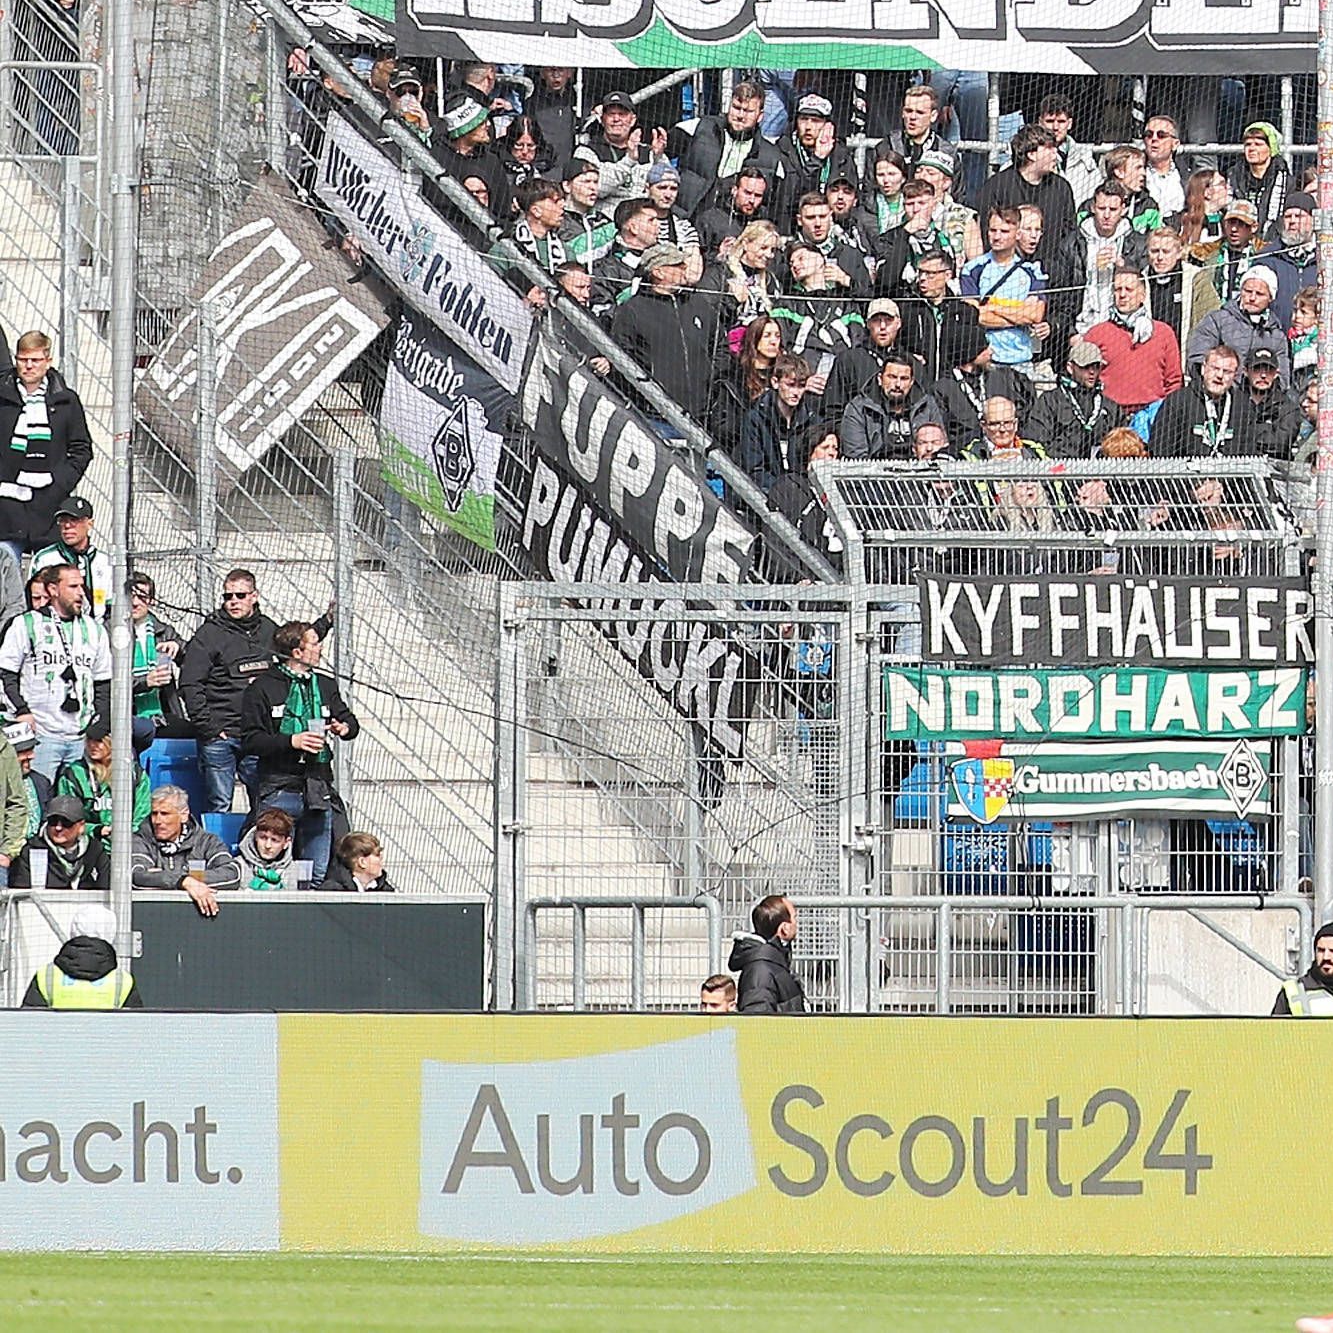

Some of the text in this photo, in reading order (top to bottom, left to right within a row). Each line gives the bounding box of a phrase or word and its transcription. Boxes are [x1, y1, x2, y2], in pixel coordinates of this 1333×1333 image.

[424, 253, 513, 364] Fohlen
[393, 317, 466, 403] Brigade
[929, 577, 1318, 664] KYFFHÄUSER
[887, 669, 1302, 735] NORDHARZ
[1020, 762, 1219, 797] Gummersbach
[0, 1100, 244, 1186] acht.
[441, 1083, 1213, 1199] Auto Scout24
